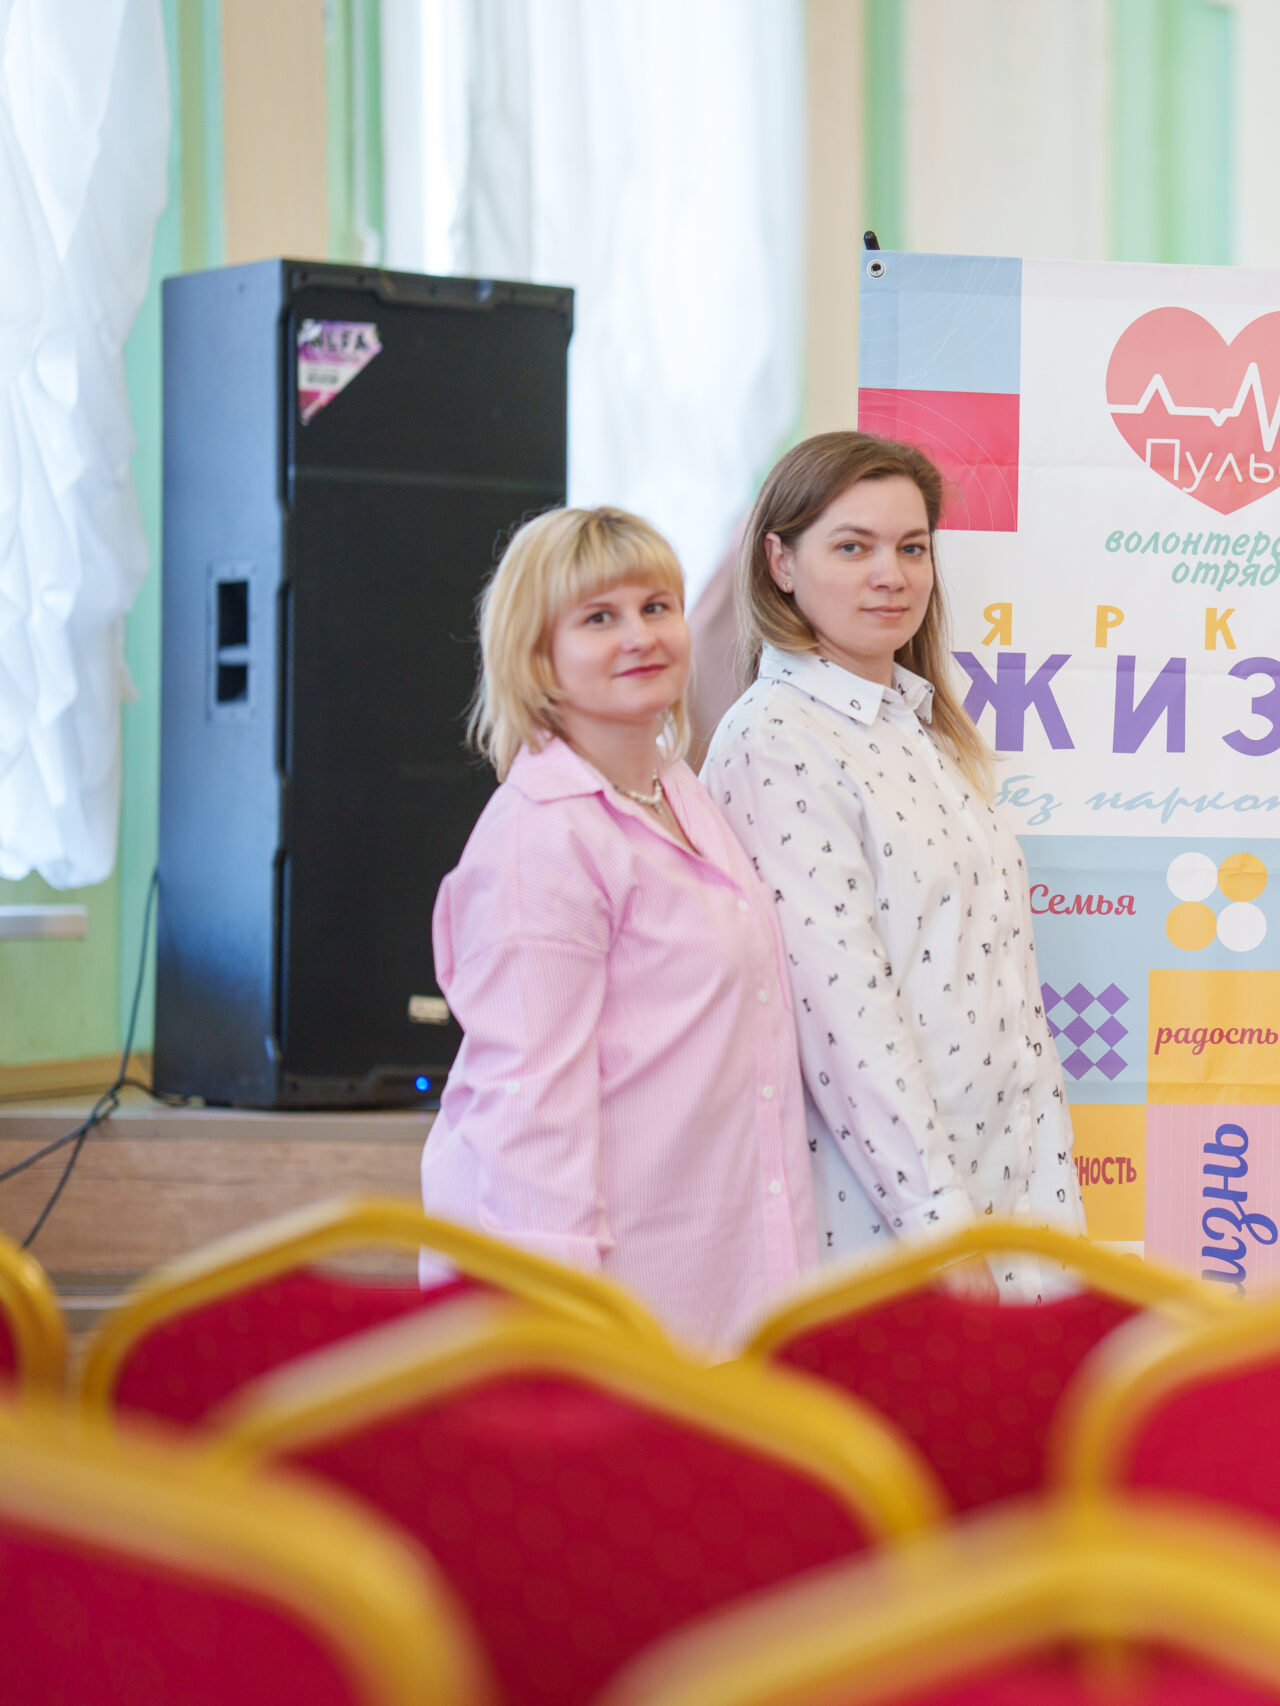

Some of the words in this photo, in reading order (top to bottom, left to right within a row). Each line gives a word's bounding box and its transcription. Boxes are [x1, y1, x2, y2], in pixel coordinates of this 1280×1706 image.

[995, 775, 1063, 826] без
[1029, 883, 1137, 916] Семья
[1154, 1027, 1279, 1055] радость
[1202, 1123, 1279, 1302] изнь
